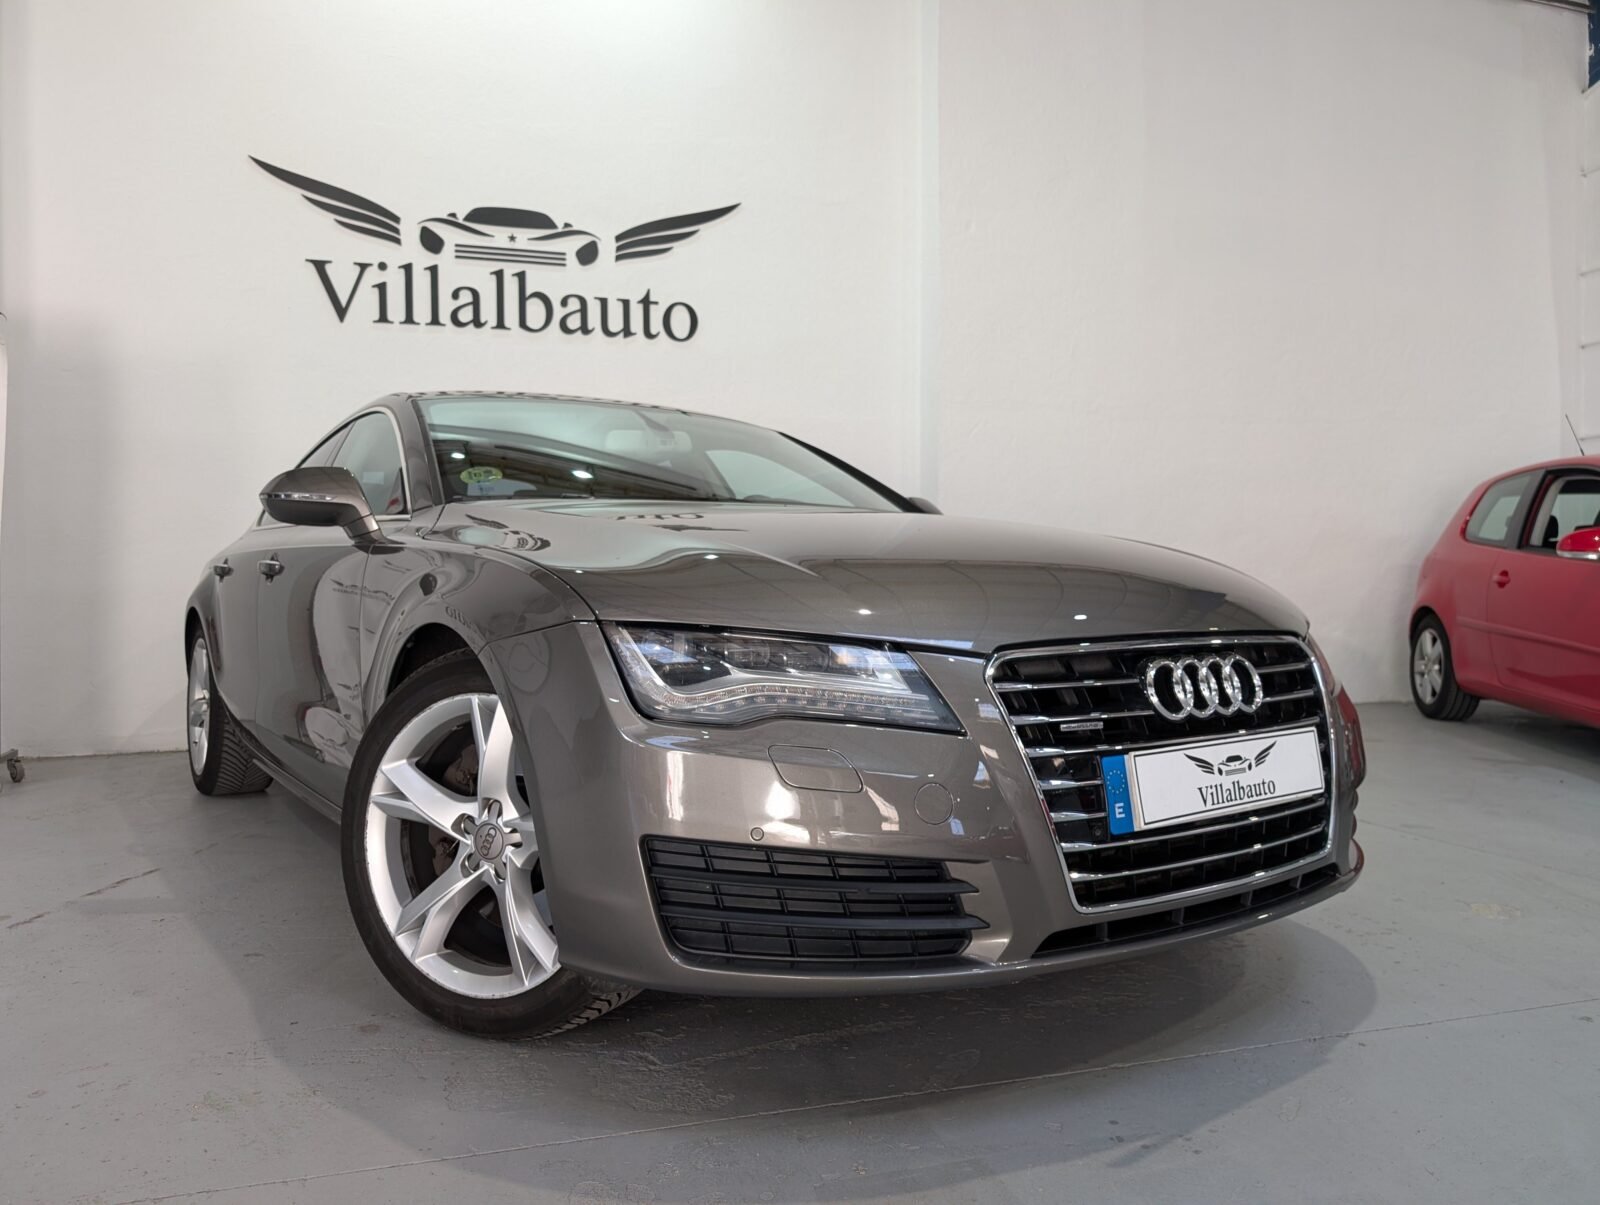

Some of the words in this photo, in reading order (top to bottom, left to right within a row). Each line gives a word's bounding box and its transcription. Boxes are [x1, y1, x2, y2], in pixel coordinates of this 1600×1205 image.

[306, 259, 698, 341] Villalbauto
[1198, 779, 1276, 808] Villalbauto
[1115, 803, 1125, 818] E
